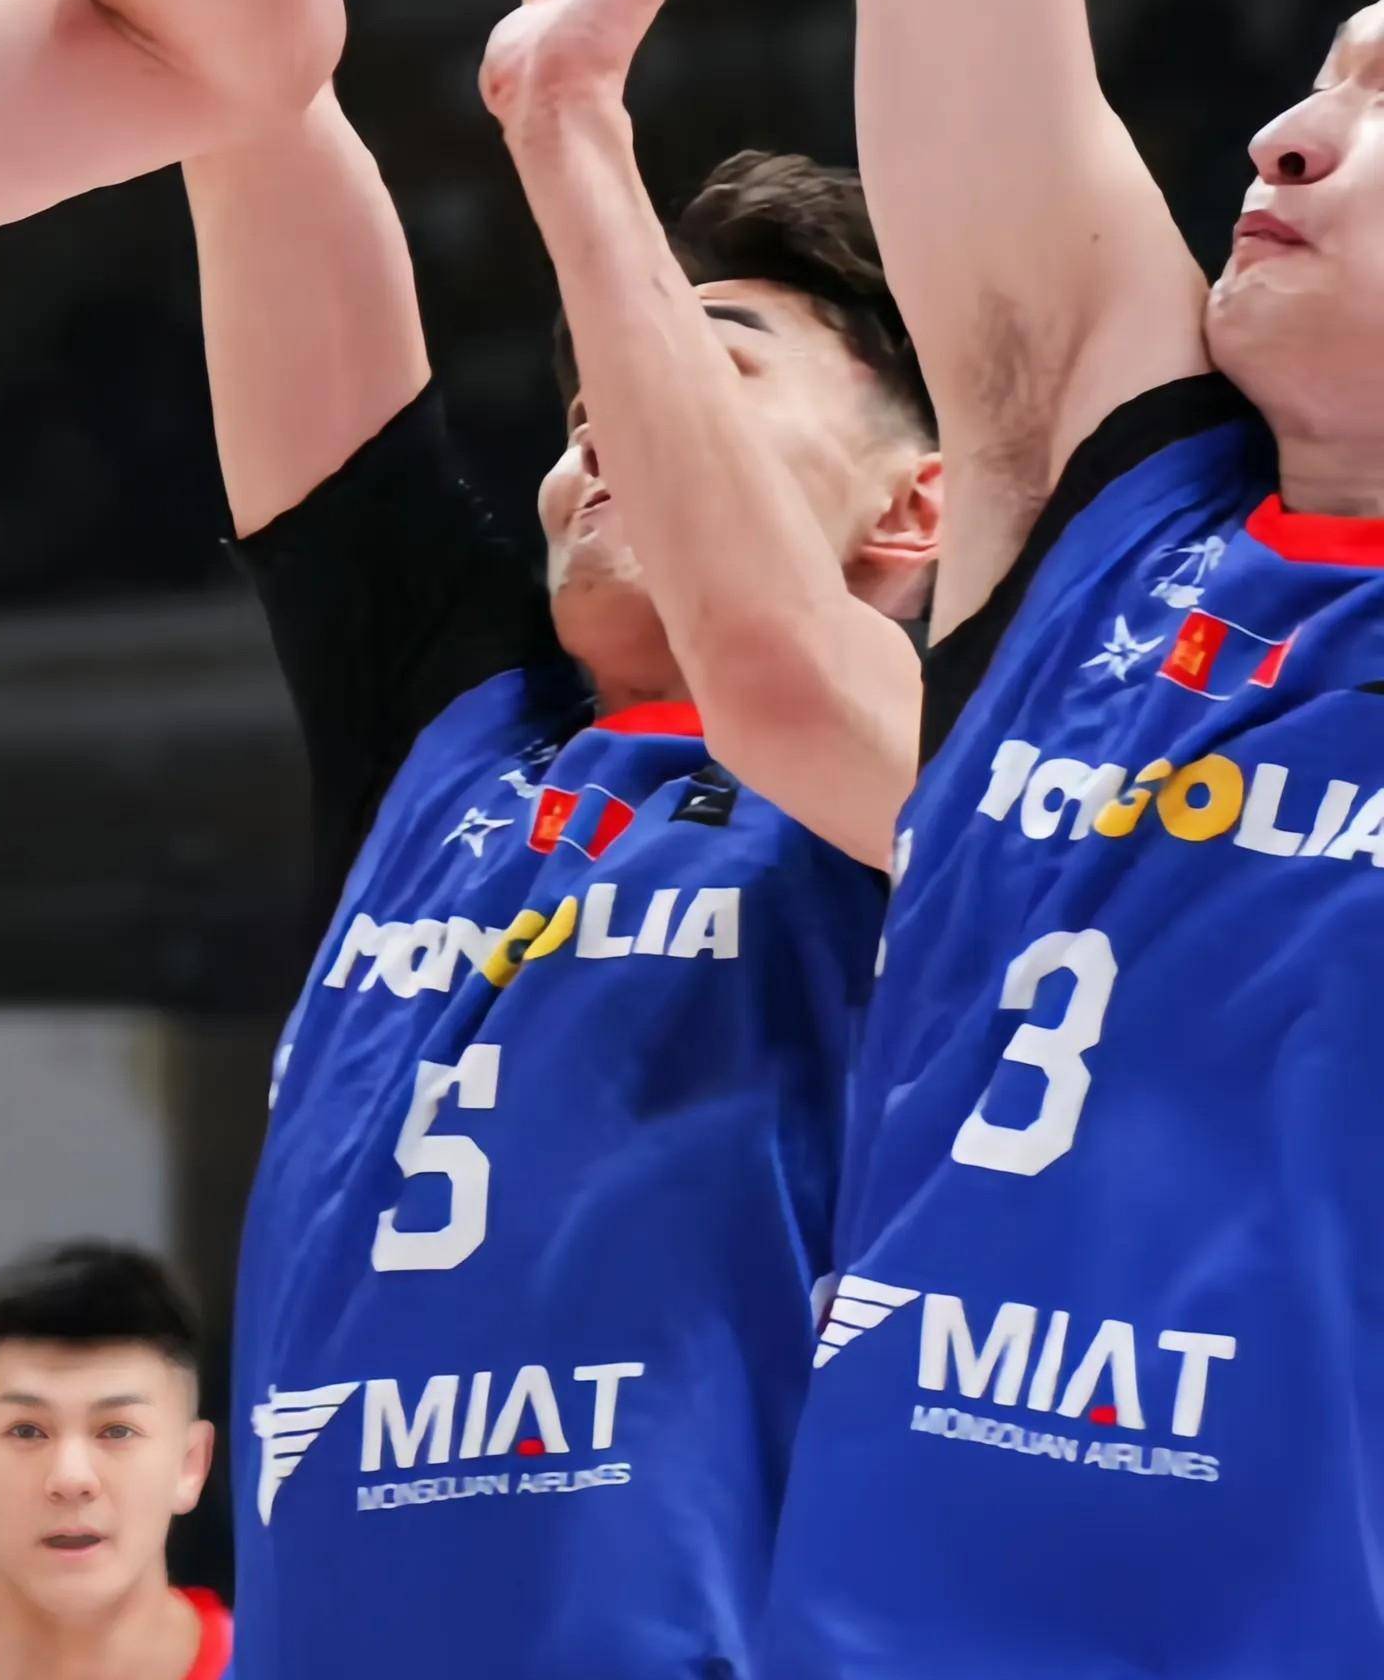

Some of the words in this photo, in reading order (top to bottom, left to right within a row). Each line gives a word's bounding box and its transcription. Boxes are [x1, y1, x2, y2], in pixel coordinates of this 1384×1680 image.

[951, 928, 1117, 1176] 3
[371, 1043, 501, 1272] 5
[360, 1362, 645, 1471] MIAT
[918, 1293, 1236, 1436] MIAT
[1084, 1441, 1220, 1482] AIRLINES
